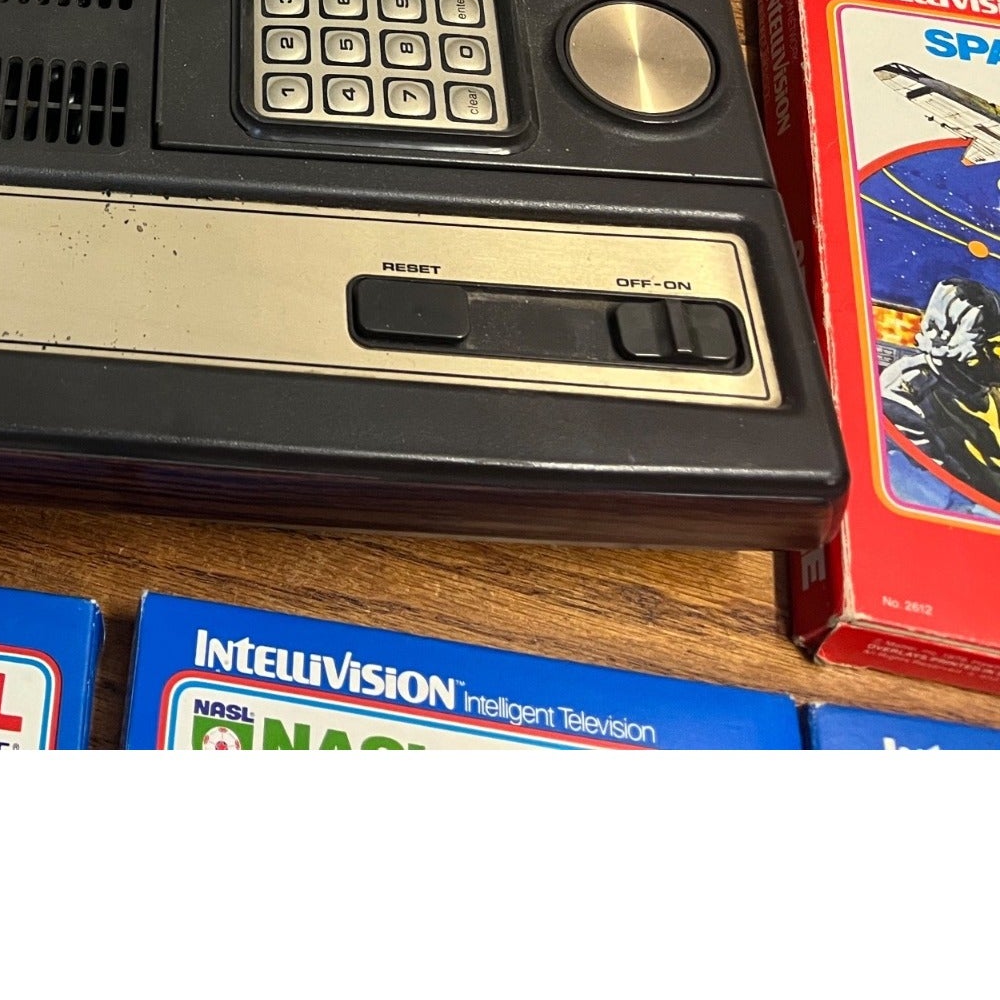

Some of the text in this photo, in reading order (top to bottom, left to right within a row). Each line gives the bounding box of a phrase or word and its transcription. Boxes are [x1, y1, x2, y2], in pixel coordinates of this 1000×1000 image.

[469, 89, 479, 115] clear
[382, 261, 442, 275] RESET
[904, 600, 934, 616] 2612
[193, 699, 255, 723] NASL
[464, 689, 556, 729] Intelligent
[557, 706, 657, 744] Television
